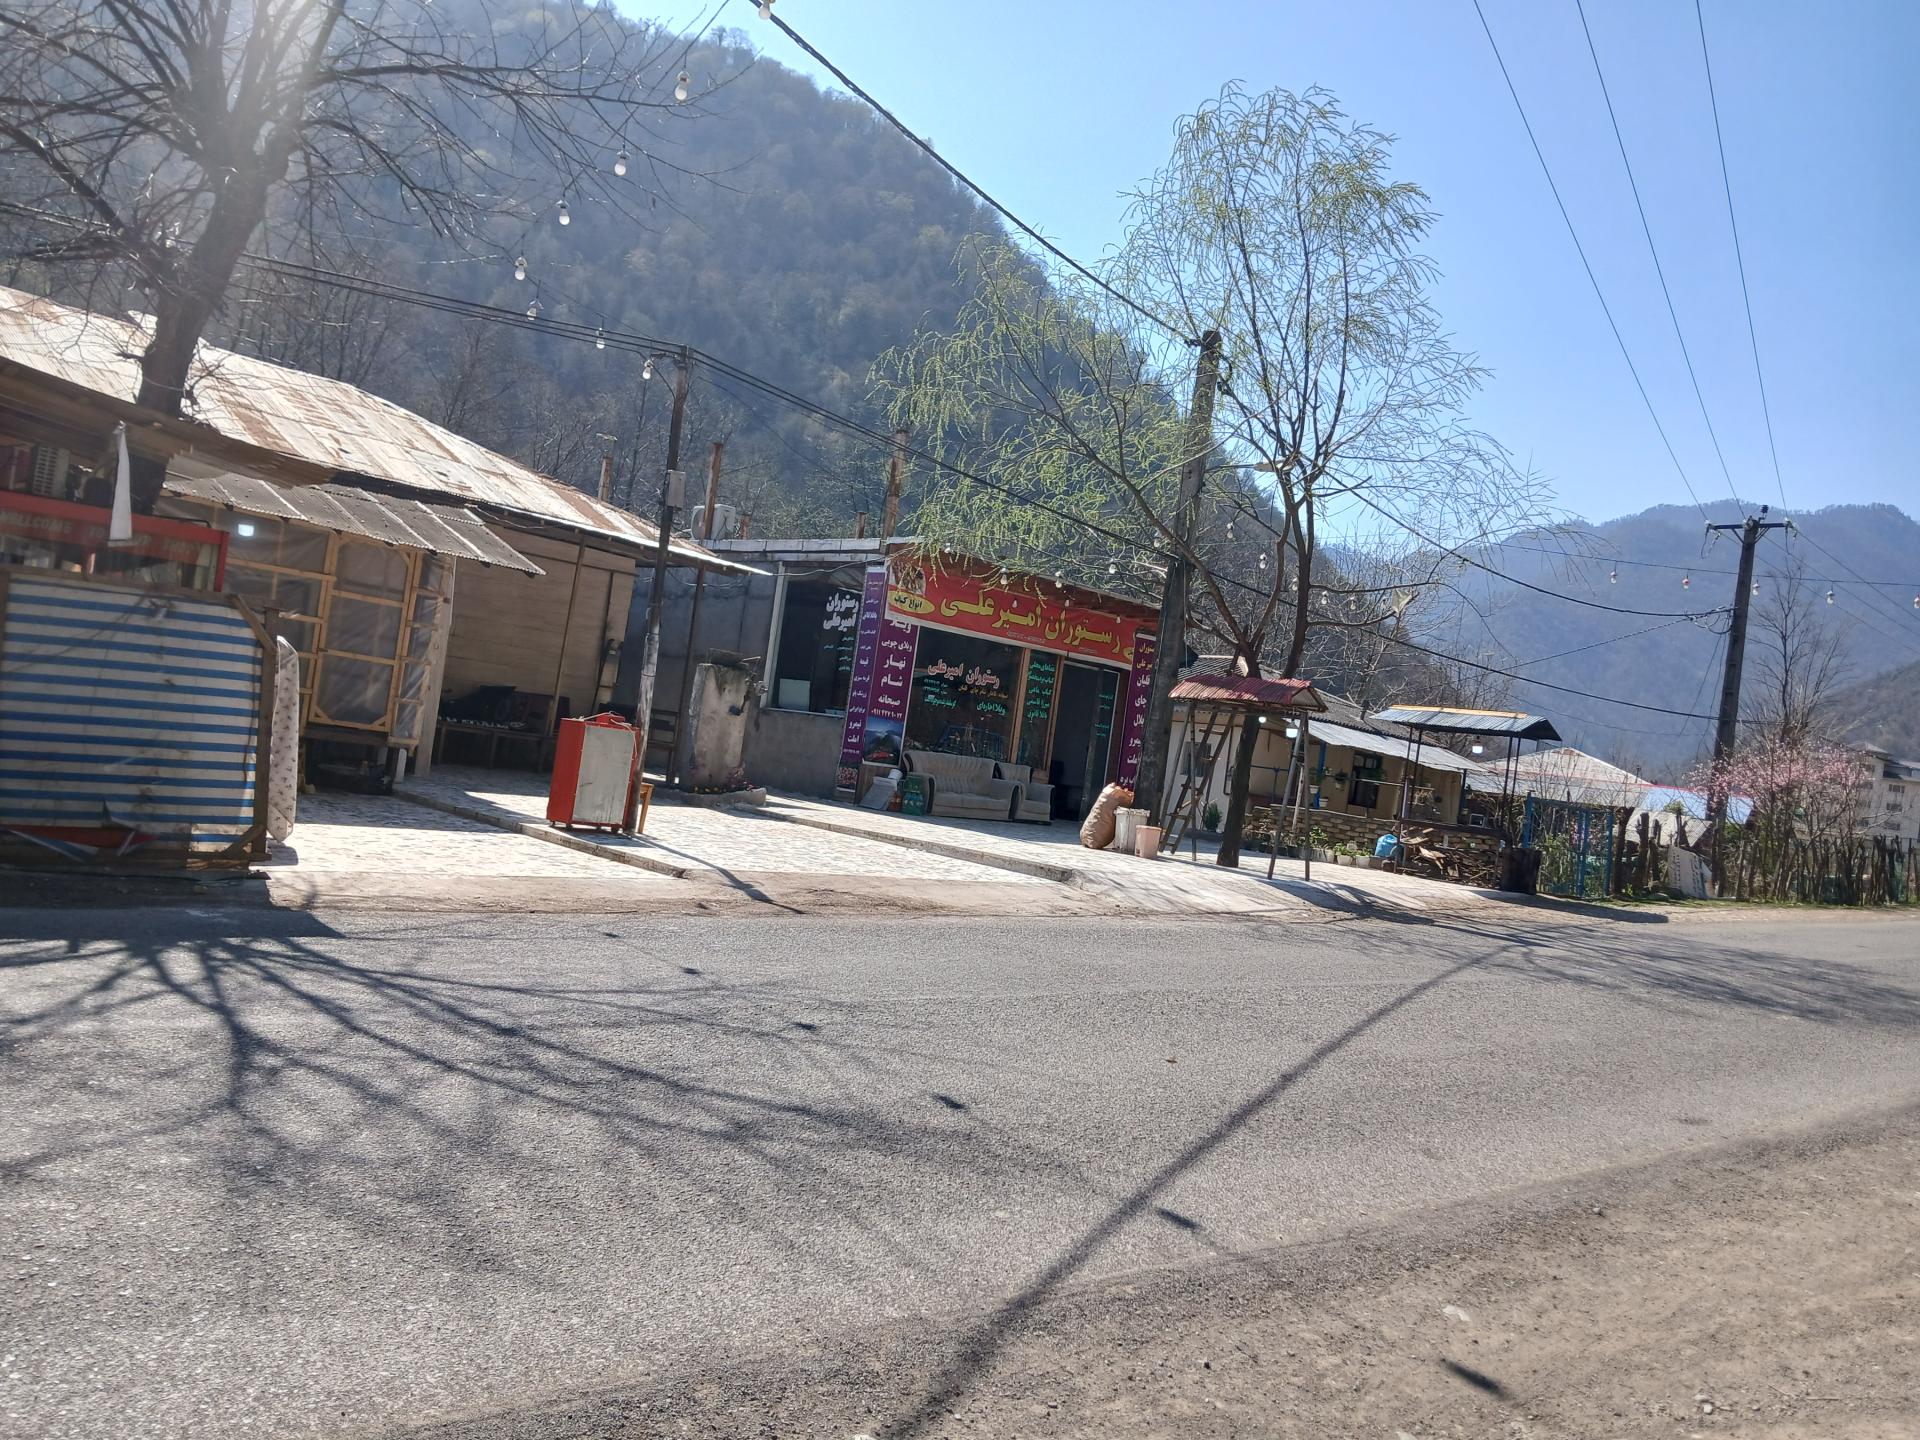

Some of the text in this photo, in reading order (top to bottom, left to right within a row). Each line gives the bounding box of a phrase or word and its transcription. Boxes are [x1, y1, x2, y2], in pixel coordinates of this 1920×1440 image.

[826, 593, 859, 612] رستوران
[1045, 608, 1121, 653] رستوران
[880, 673, 904, 687] شام
[966, 666, 1000, 689] رستوران
[877, 694, 901, 708] صبحانه
